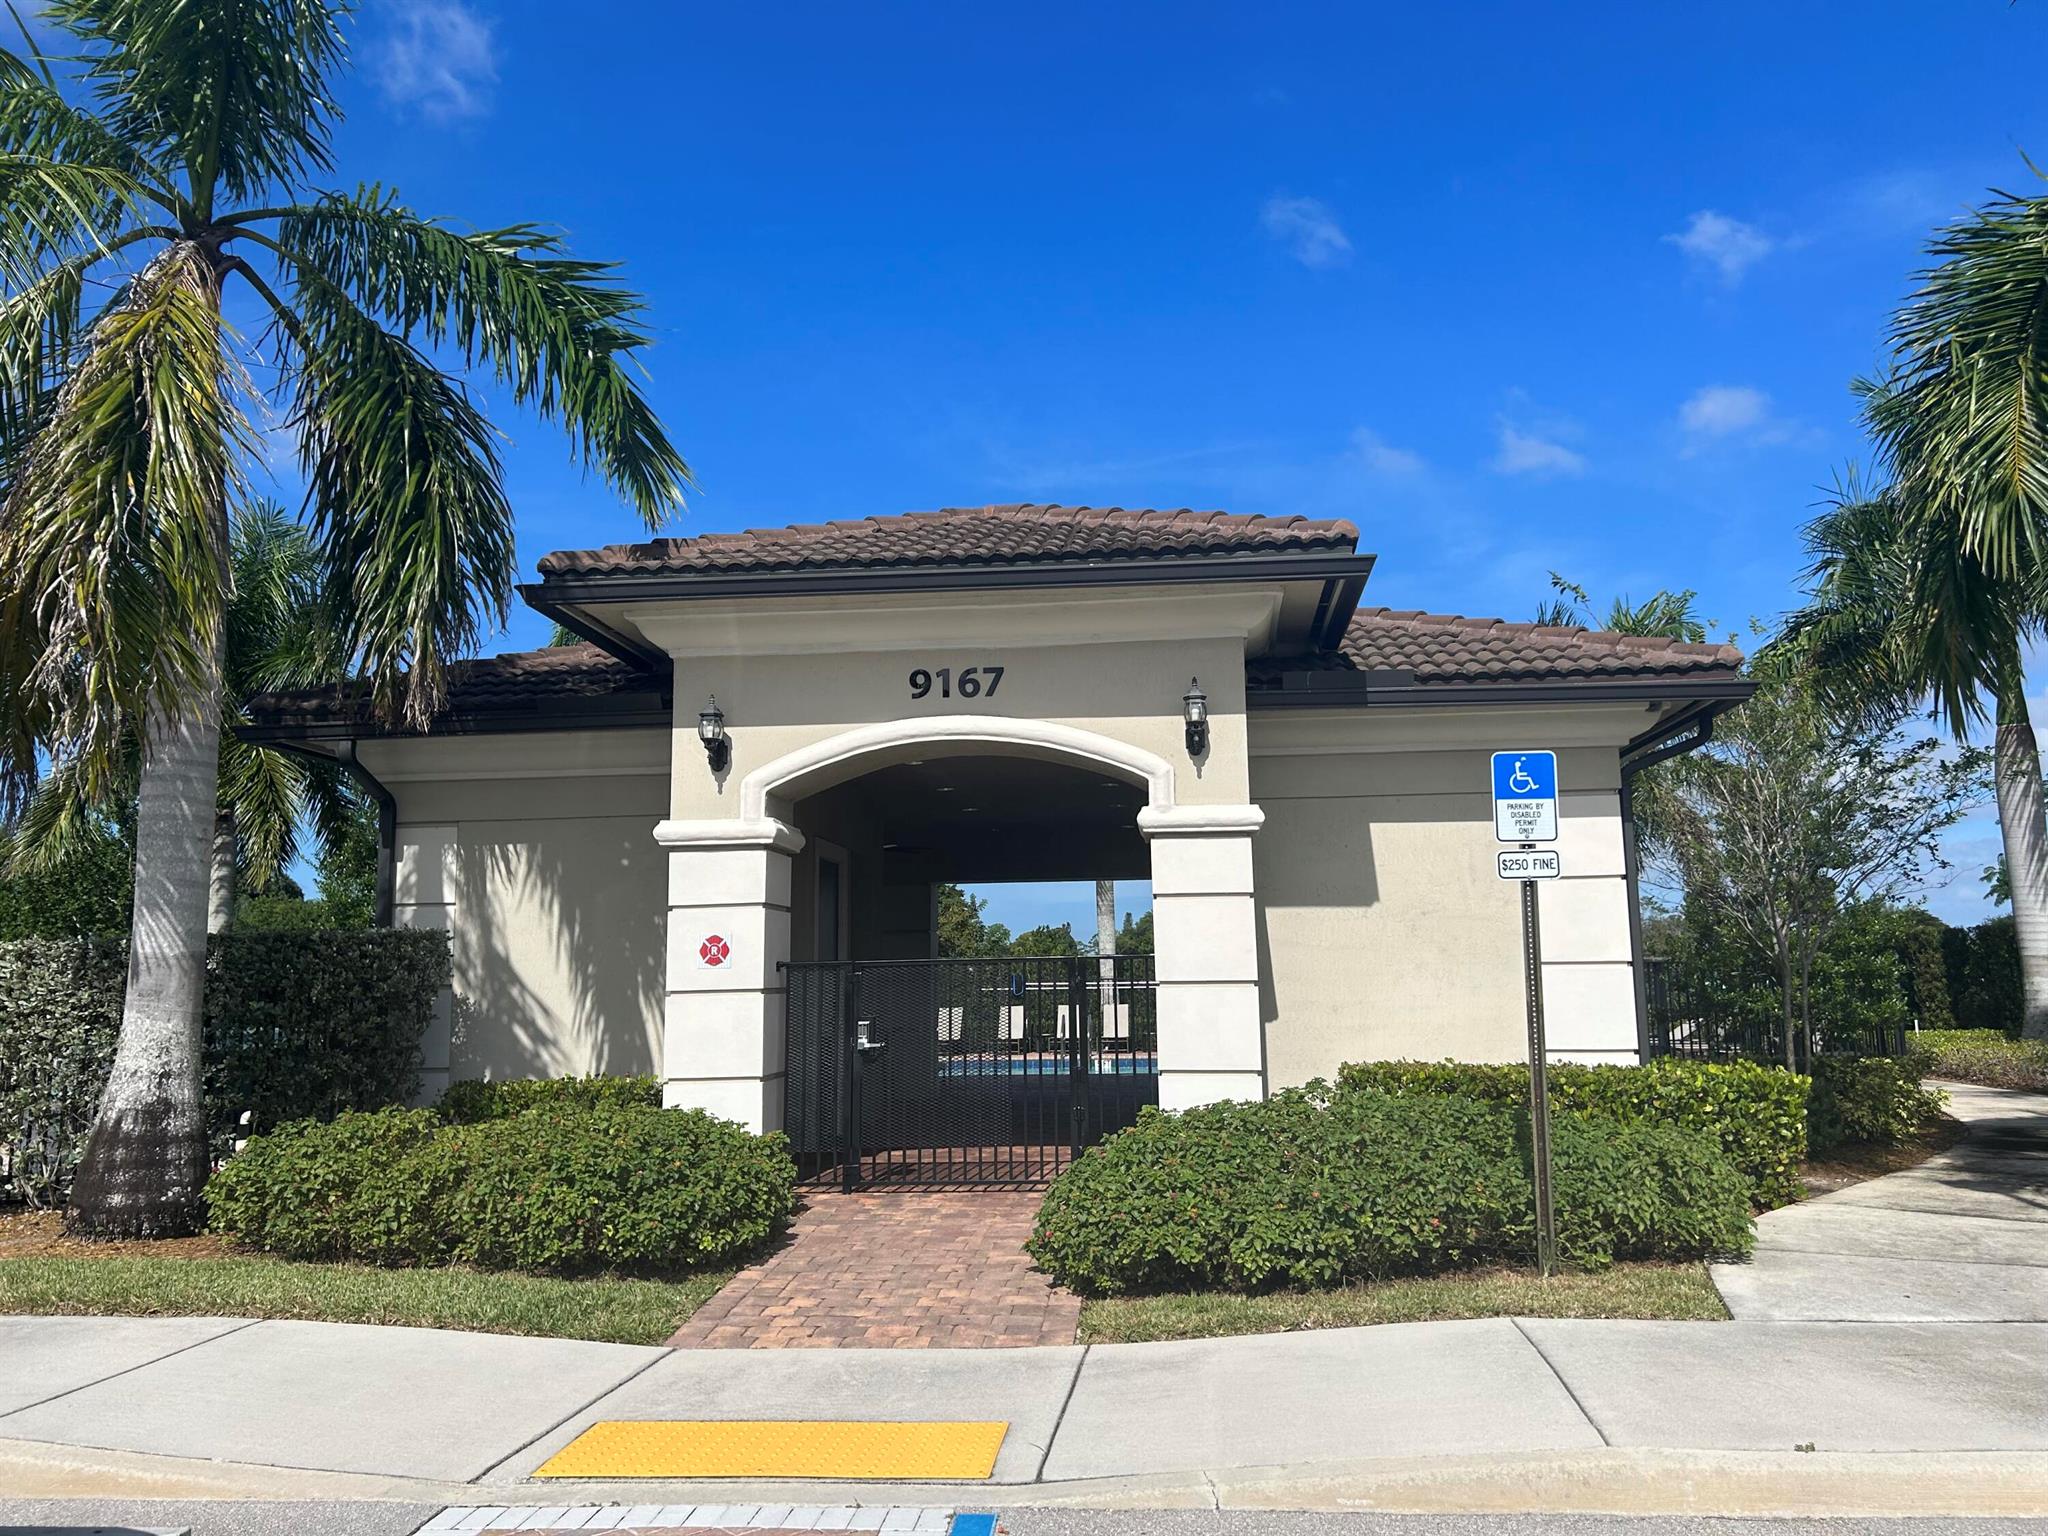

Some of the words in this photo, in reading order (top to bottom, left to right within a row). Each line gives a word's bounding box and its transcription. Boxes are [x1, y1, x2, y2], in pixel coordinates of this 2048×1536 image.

[909, 667, 1005, 699] 9167
[1502, 859, 1529, 871] $250
[1533, 858, 1556, 870] FINE
[711, 946, 718, 955] R
